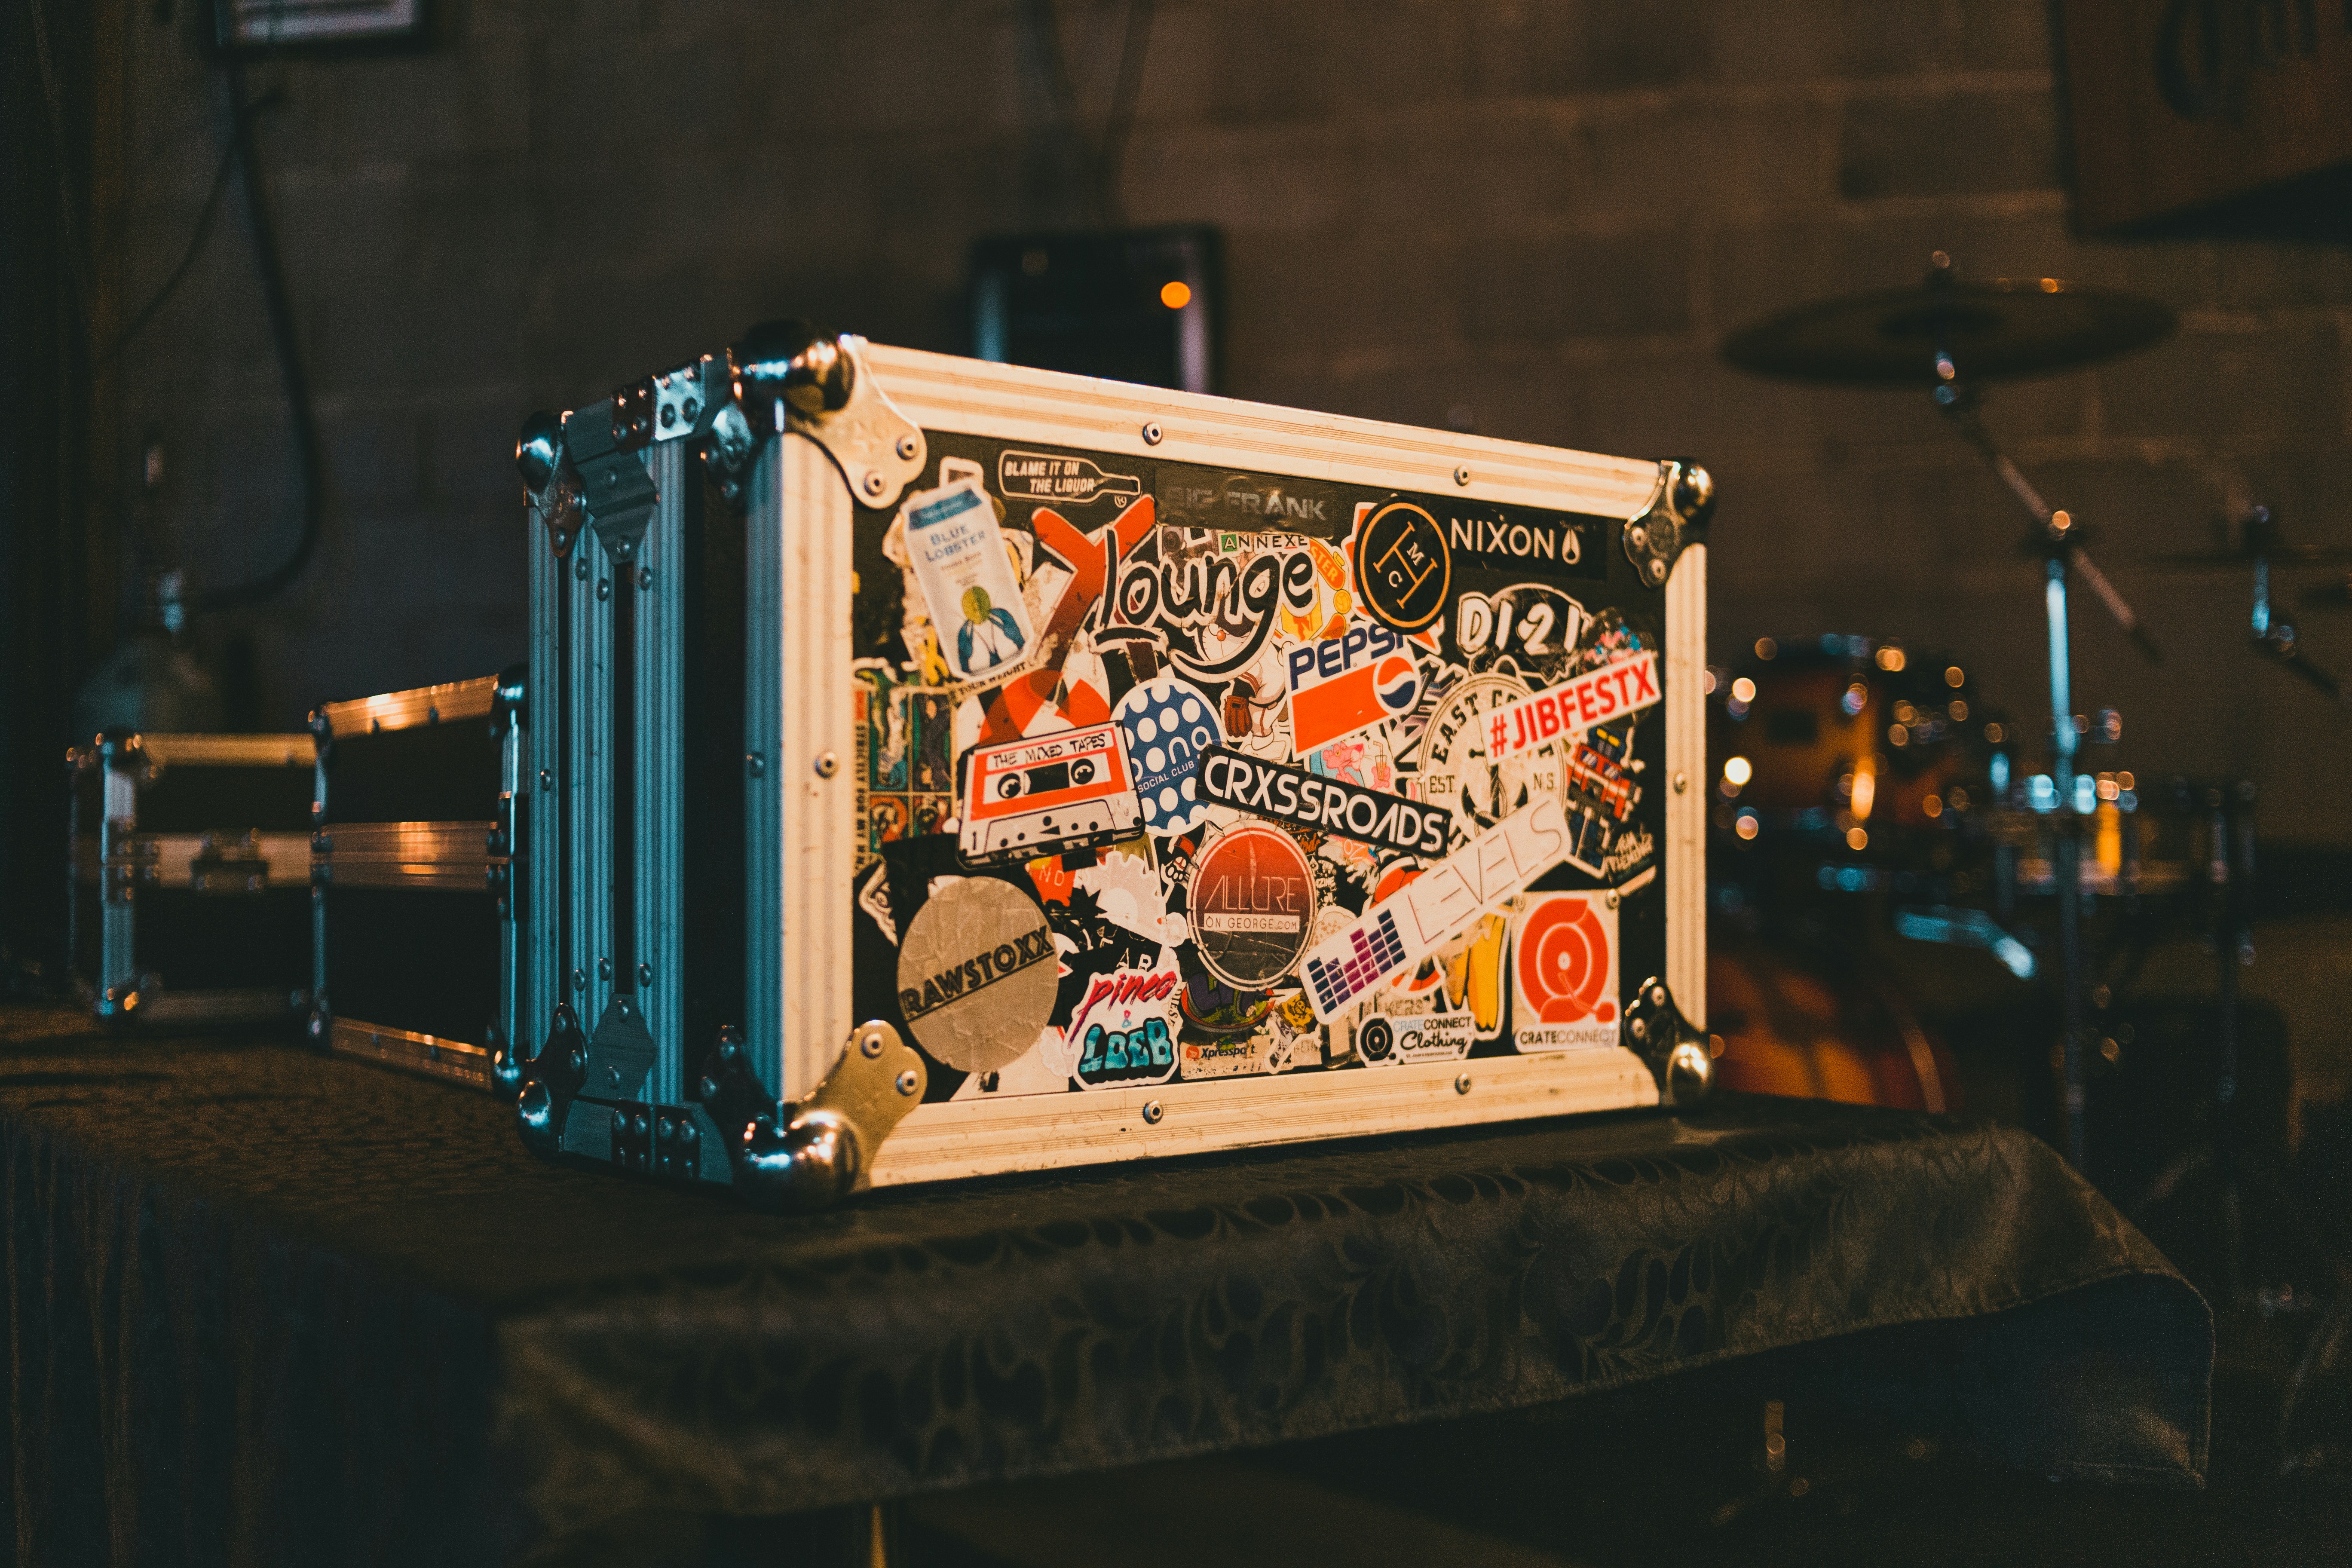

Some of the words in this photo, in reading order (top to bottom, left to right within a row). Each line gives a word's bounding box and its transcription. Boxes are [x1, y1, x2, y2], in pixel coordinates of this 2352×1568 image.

[1004, 461, 1047, 477] BLAME
[1049, 461, 1061, 476] IT
[1064, 461, 1081, 476] ON
[1029, 478, 1052, 493] THE
[1055, 478, 1095, 493] LIQUOR
[1227, 490, 1327, 521] FRANK
[925, 530, 986, 562] LOBSTER
[930, 525, 969, 546] BLUE
[1224, 533, 1308, 550] ANNEXE
[1451, 518, 1555, 560] NIXON
[1489, 659, 1656, 759] #JIBFESTX
[1431, 690, 1479, 765] EAST
[993, 751, 1017, 769] THE
[1025, 744, 1063, 763] MIXED
[1070, 733, 1106, 753] TAPES
[1137, 773, 1170, 793] SOCIAL
[1171, 760, 1195, 777] CLUB
[1205, 755, 1443, 851] CRXSSROADS
[1408, 800, 1562, 944] LEVELS
[1204, 874, 1302, 912] ALLURE
[1205, 915, 1222, 928] ON
[899, 925, 1054, 1015] RAWSTOXX
[1079, 1020, 1173, 1074] LOEB
[1400, 1030, 1468, 1054] Clothing
